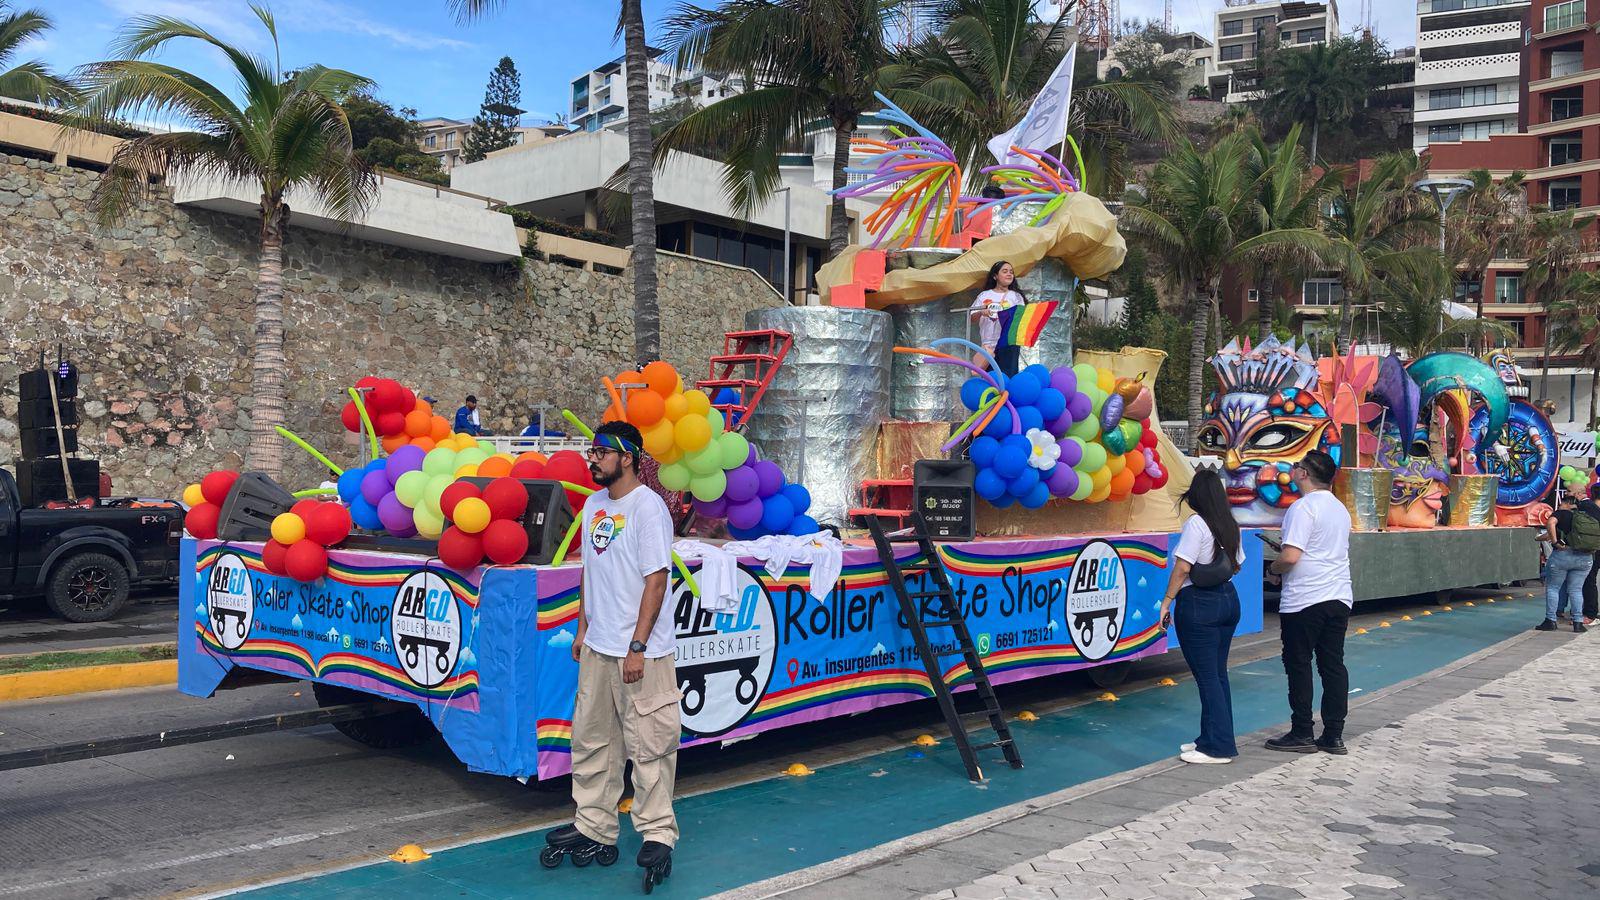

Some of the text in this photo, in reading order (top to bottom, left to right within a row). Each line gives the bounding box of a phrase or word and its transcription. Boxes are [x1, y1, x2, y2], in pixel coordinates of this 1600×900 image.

[142, 515, 167, 525] FX4
[212, 566, 247, 594] ARGO
[1073, 557, 1119, 593] ARGO
[255, 578, 389, 637] Roller Skate Shop
[398, 585, 451, 623] ARGO
[783, 579, 884, 645] Roller
[1000, 566, 1062, 624] Shop
[1072, 592, 1119, 608] ROLLERSKATE
[331, 634, 339, 644] 17
[396, 620, 451, 639] ROLLERSKATE
[996, 626, 1053, 649] 6691 725121
[371, 640, 392, 655] 725121
[674, 635, 760, 662] OLLERSKATE
[802, 661, 820, 679] Av.
[825, 650, 895, 676] insurgentes
[899, 645, 921, 663] 119
